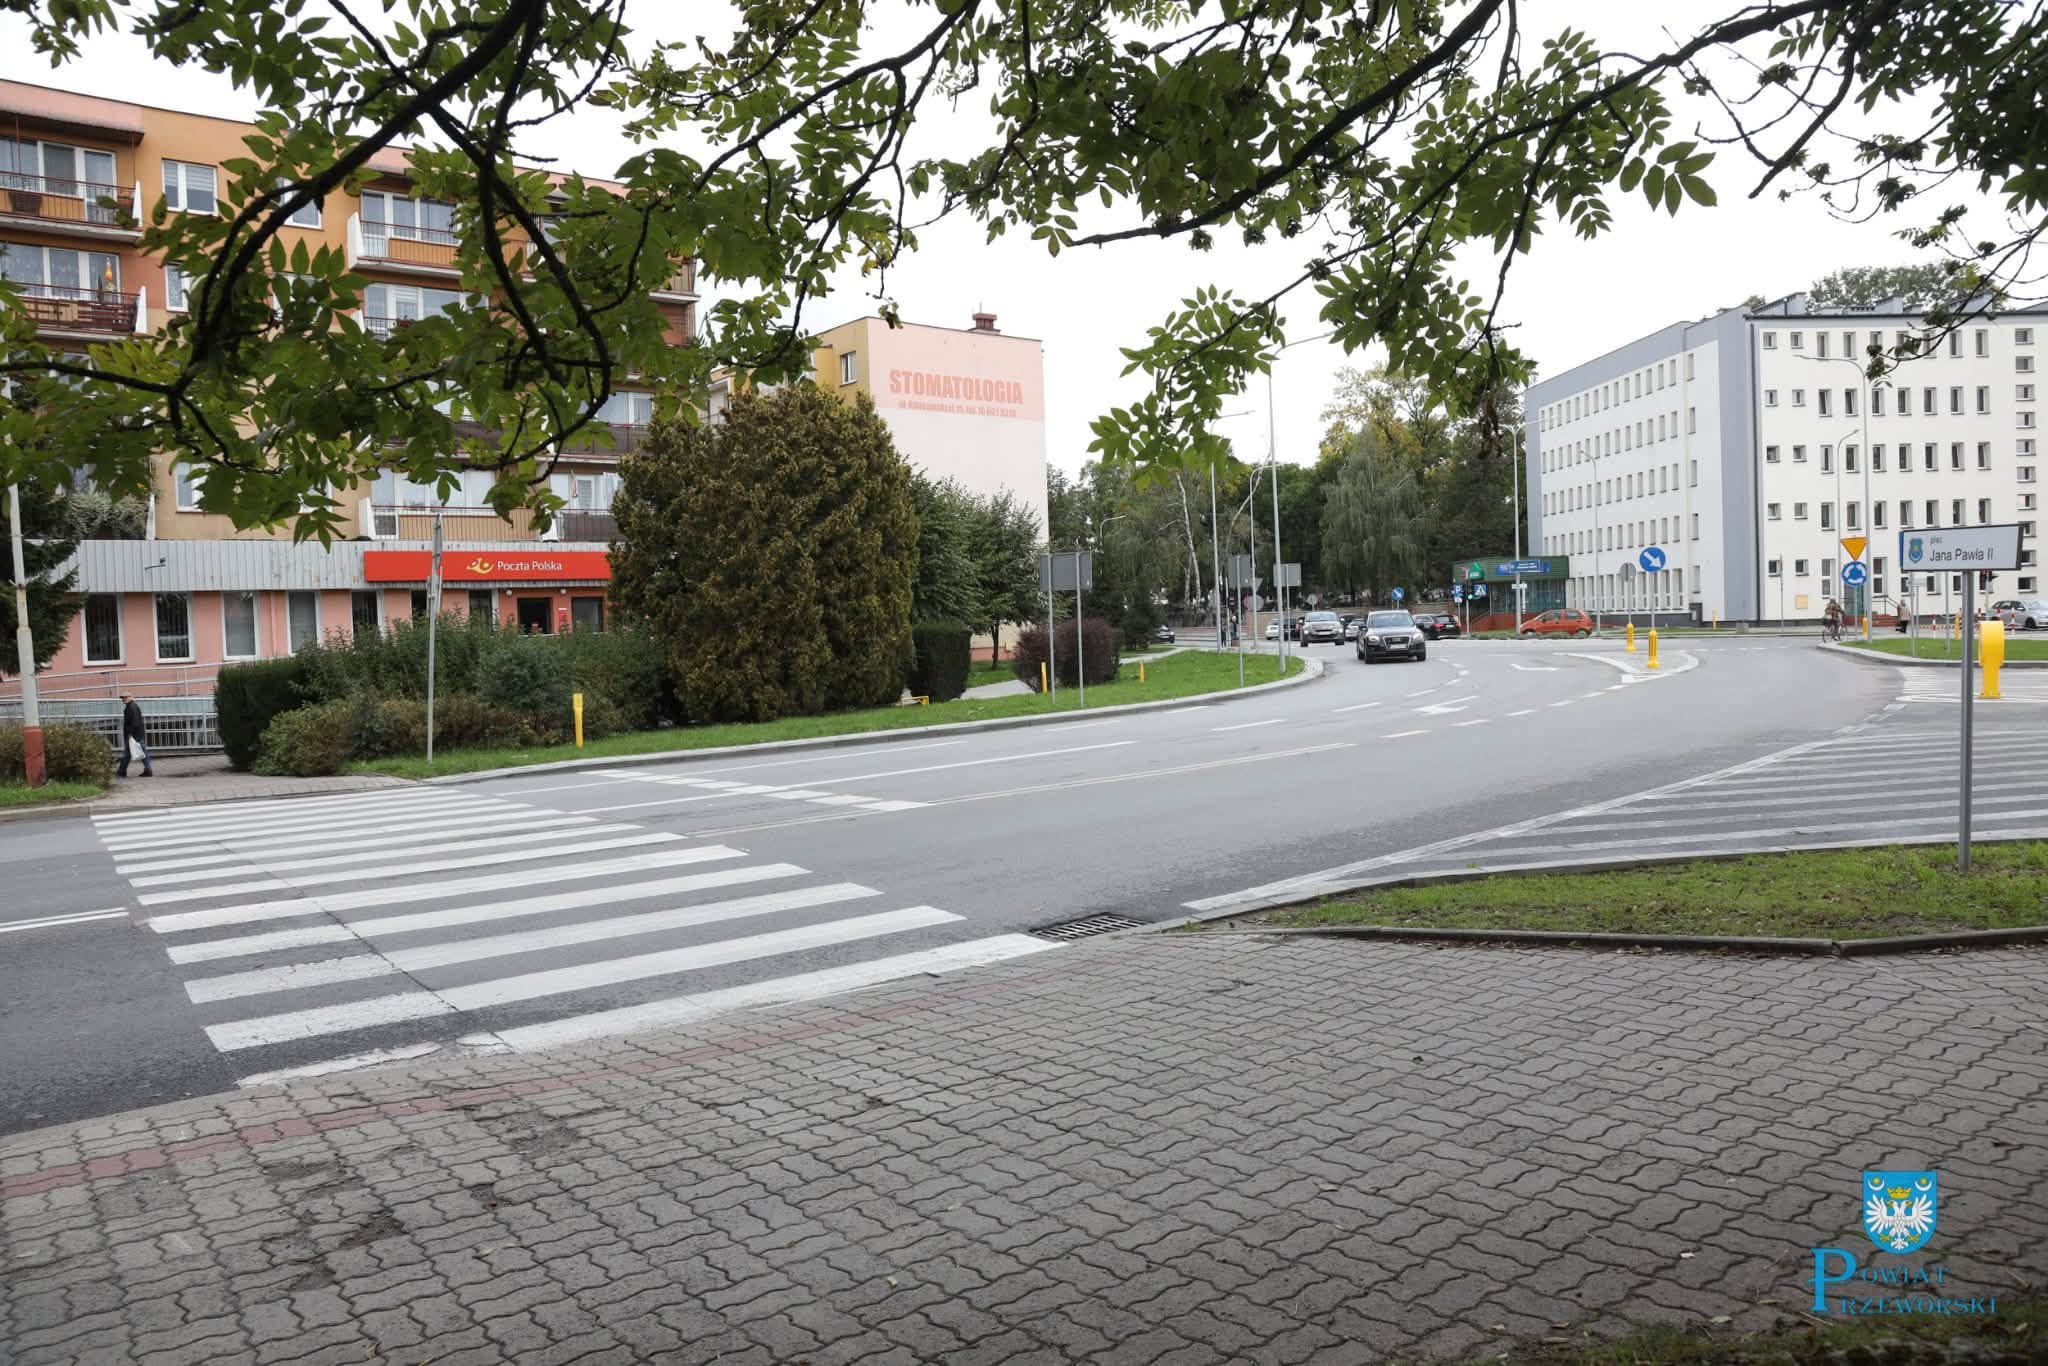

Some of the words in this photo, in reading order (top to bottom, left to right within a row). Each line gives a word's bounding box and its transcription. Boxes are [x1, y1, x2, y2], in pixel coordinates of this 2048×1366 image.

[889, 368, 1023, 405] STOMATOLOGIA
[1930, 549, 1952, 562] Jana
[1955, 548, 1984, 561] Pawła
[1987, 547, 1994, 560] II
[497, 560, 530, 572] Poczta
[532, 560, 563, 571] Polska
